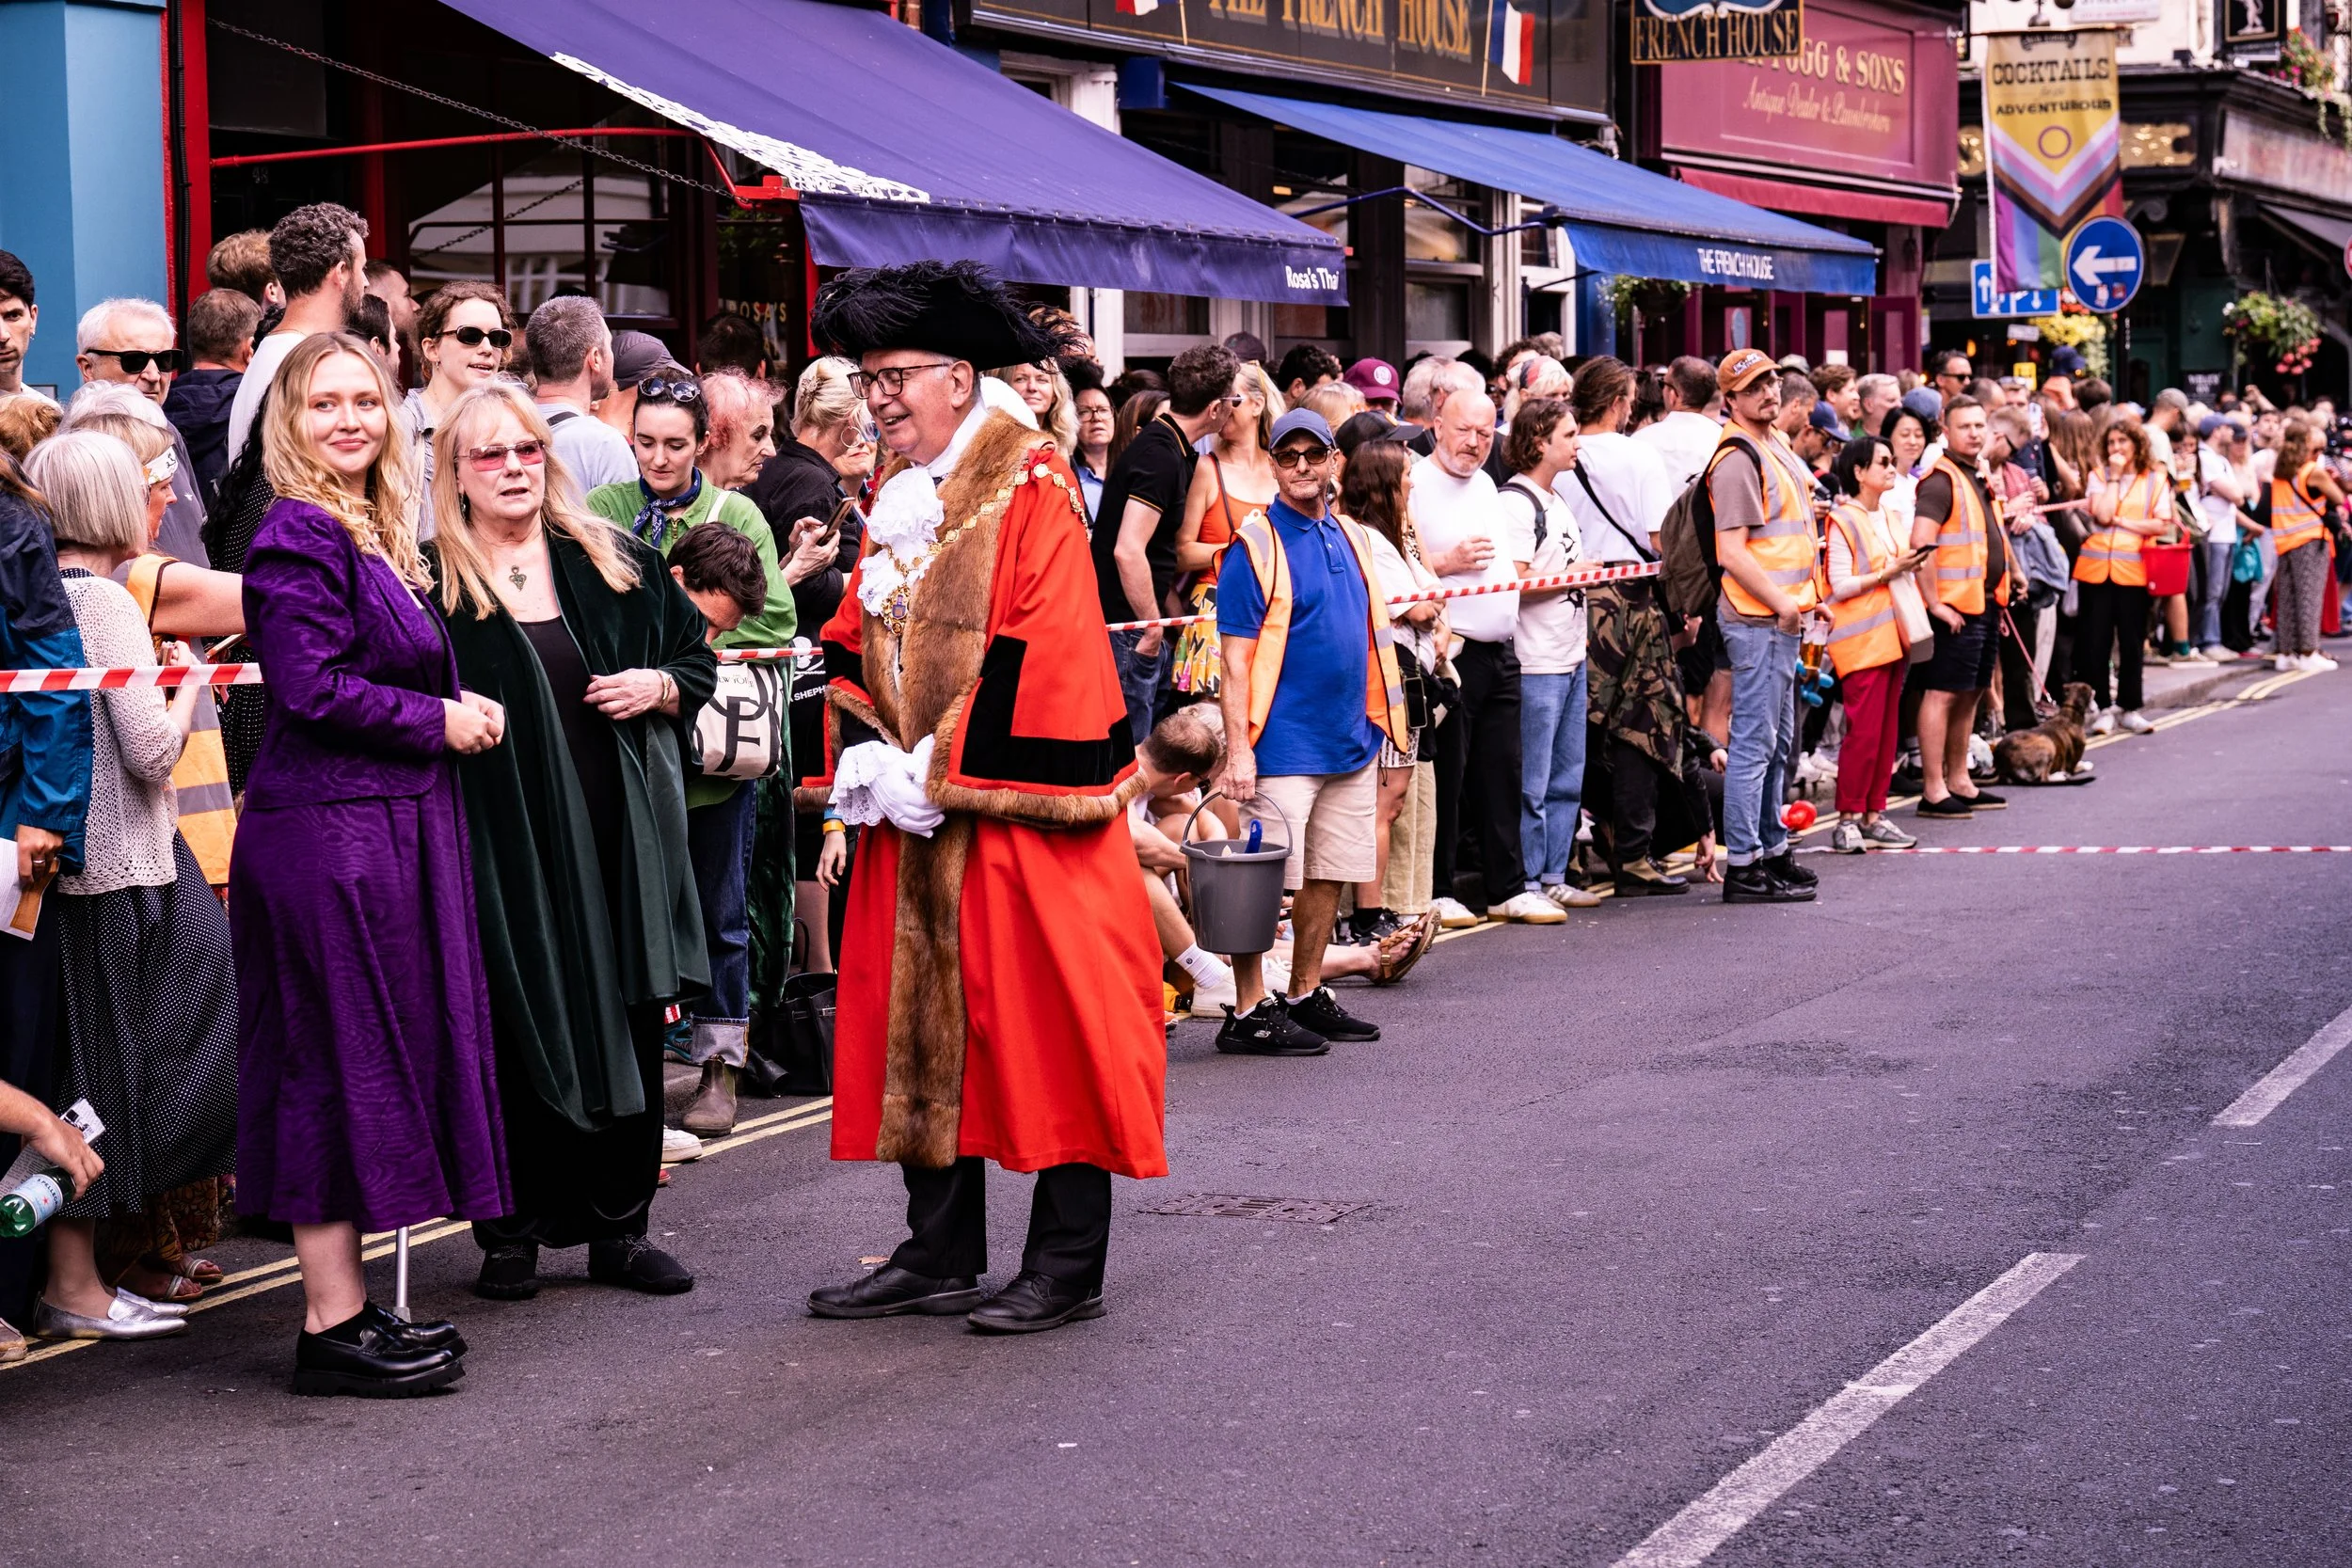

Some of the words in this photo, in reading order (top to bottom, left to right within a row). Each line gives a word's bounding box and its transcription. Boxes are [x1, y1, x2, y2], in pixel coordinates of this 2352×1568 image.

[1635, 14, 1721, 60] FRENCH
[1726, 9, 1798, 56] HOUSE
[1772, 38, 1830, 79] GG
[1836, 46, 1851, 84] &
[1855, 50, 1906, 95] SONS
[1992, 58, 2110, 86] COCKTAILS
[1995, 99, 2112, 116] ADVENTUROUS
[1285, 265, 1319, 290] Rosa's
[1316, 267, 1340, 290] Thai
[1697, 248, 1716, 275] THE
[1715, 249, 1746, 277] FRENCH
[1745, 253, 1774, 280] HOUSE
